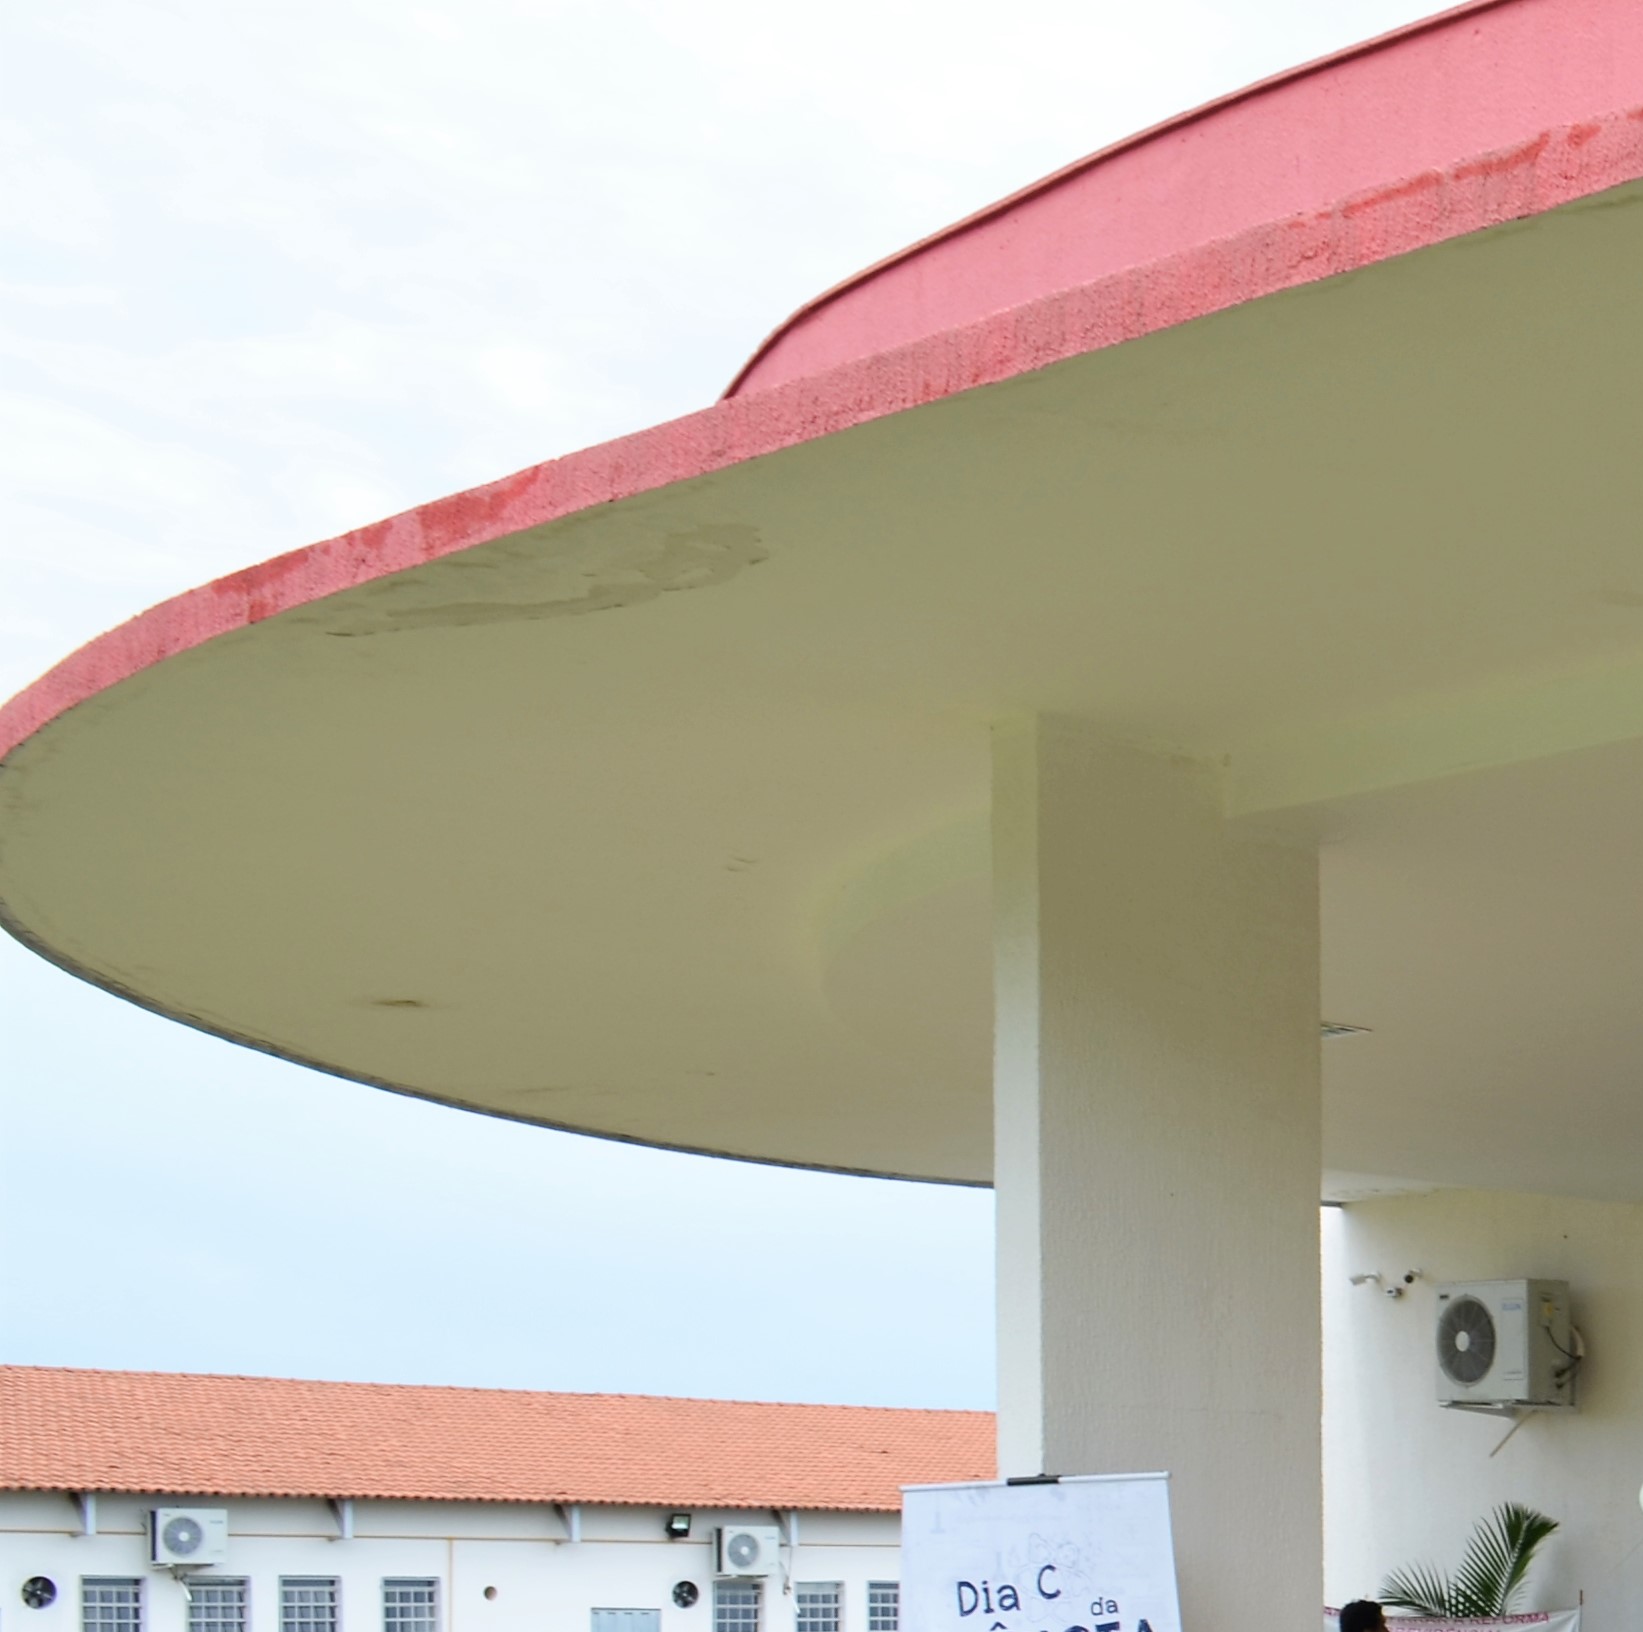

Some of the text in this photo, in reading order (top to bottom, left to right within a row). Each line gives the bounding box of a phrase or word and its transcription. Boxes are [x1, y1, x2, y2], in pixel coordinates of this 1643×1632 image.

[957, 1564, 1119, 1617] Dia C da
